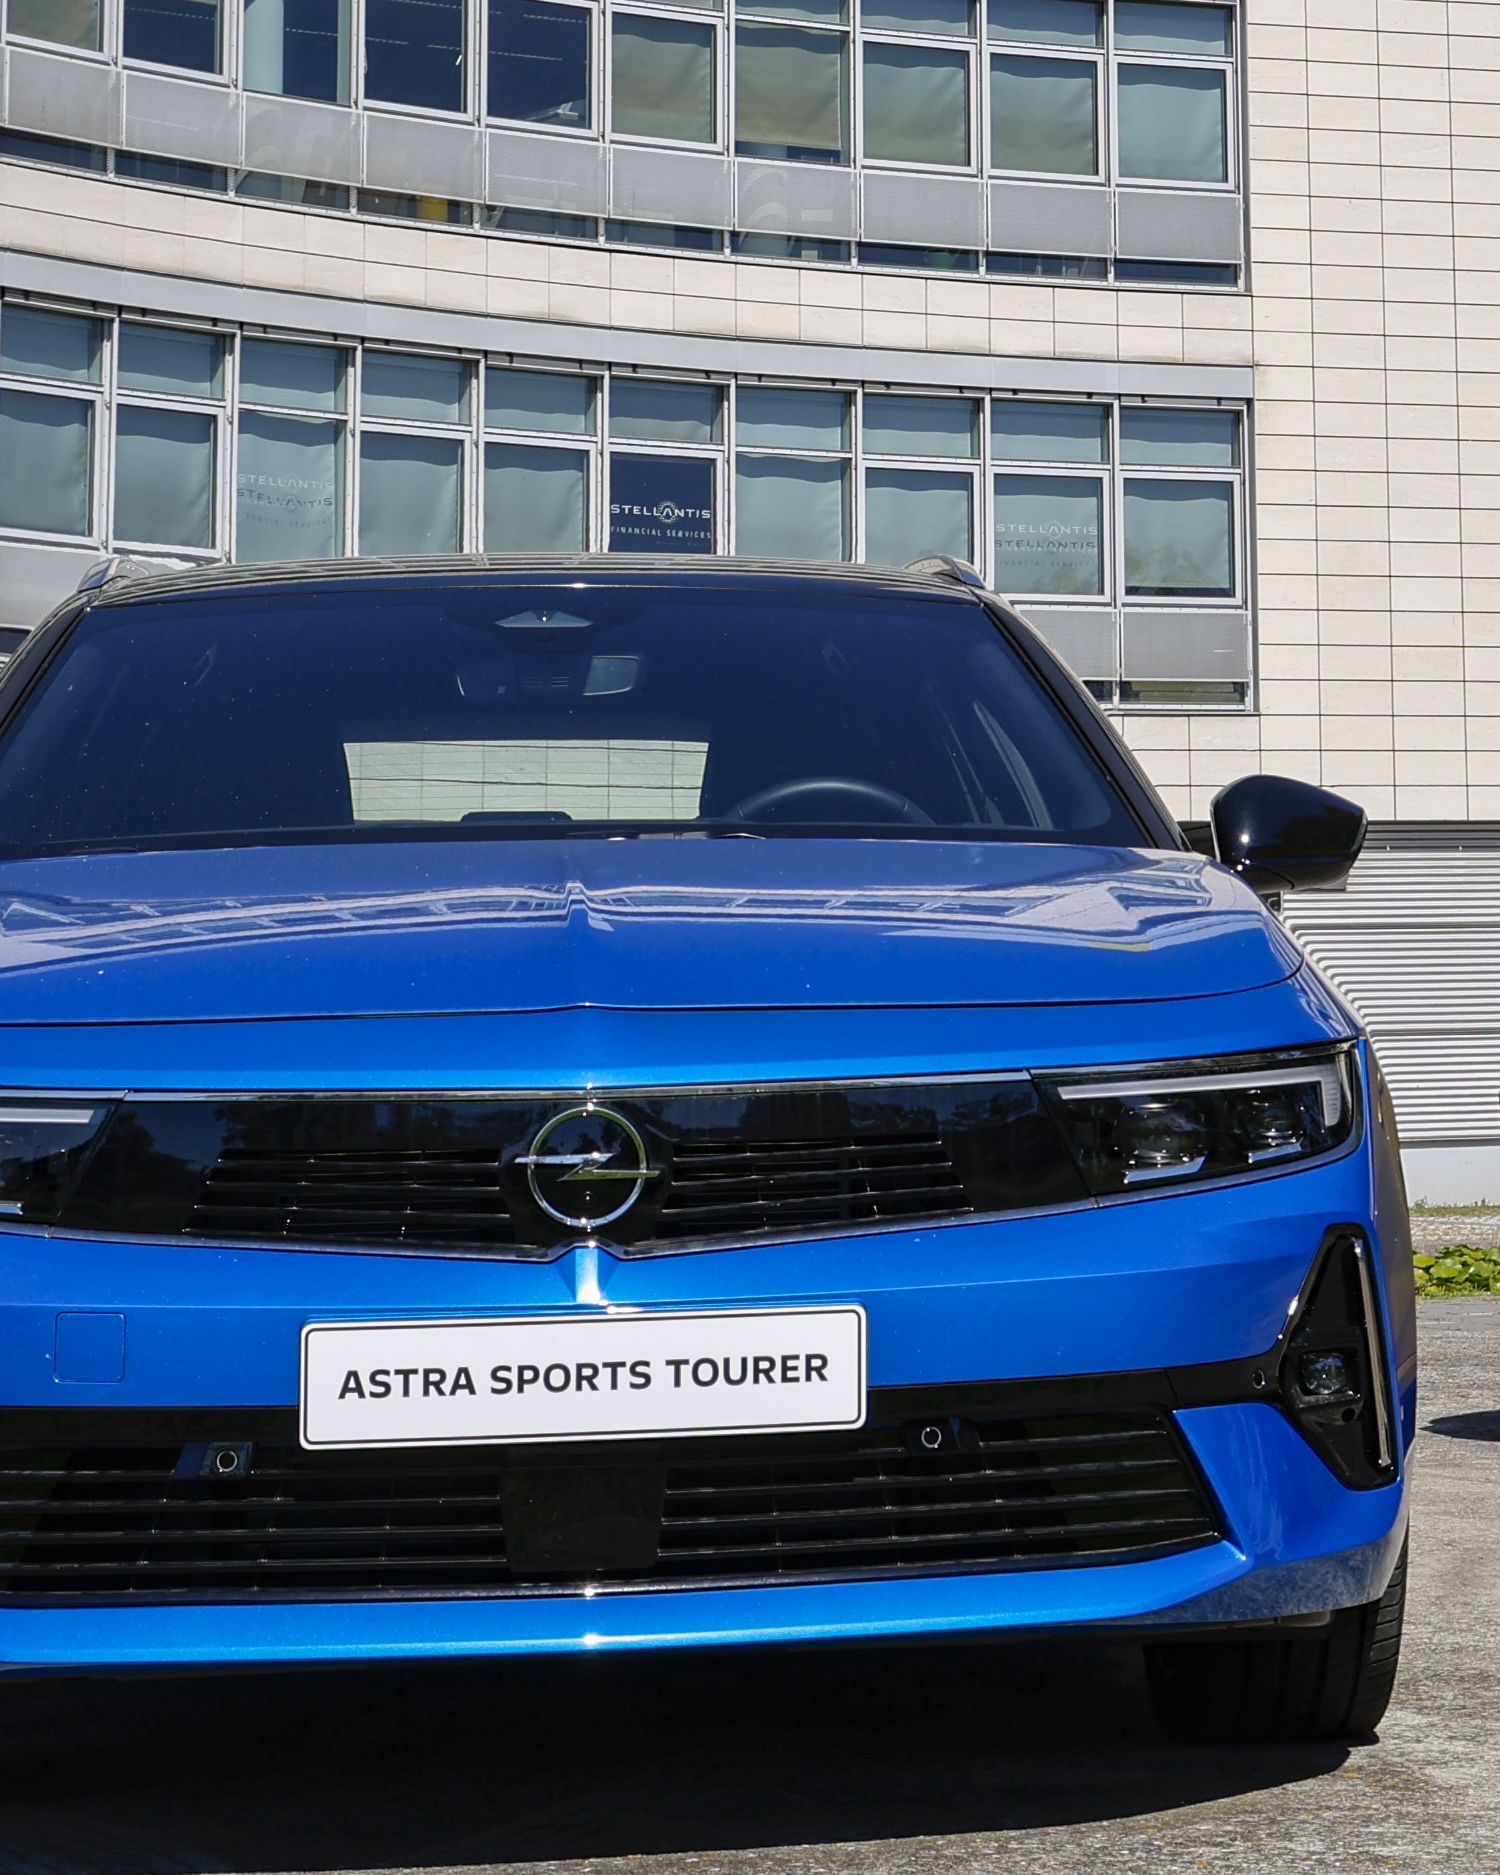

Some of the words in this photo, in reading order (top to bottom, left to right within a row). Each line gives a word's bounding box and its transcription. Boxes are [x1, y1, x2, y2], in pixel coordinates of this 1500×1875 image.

[610, 504, 711, 519] STELLANTIS
[611, 525, 662, 537] FINANCIAL
[666, 529, 711, 539] SERVICES
[996, 523, 1099, 535] STELLANTIS
[337, 1366, 478, 1400] ASTRA
[489, 1359, 653, 1396] SPORTS
[664, 1352, 830, 1389] TOURER
